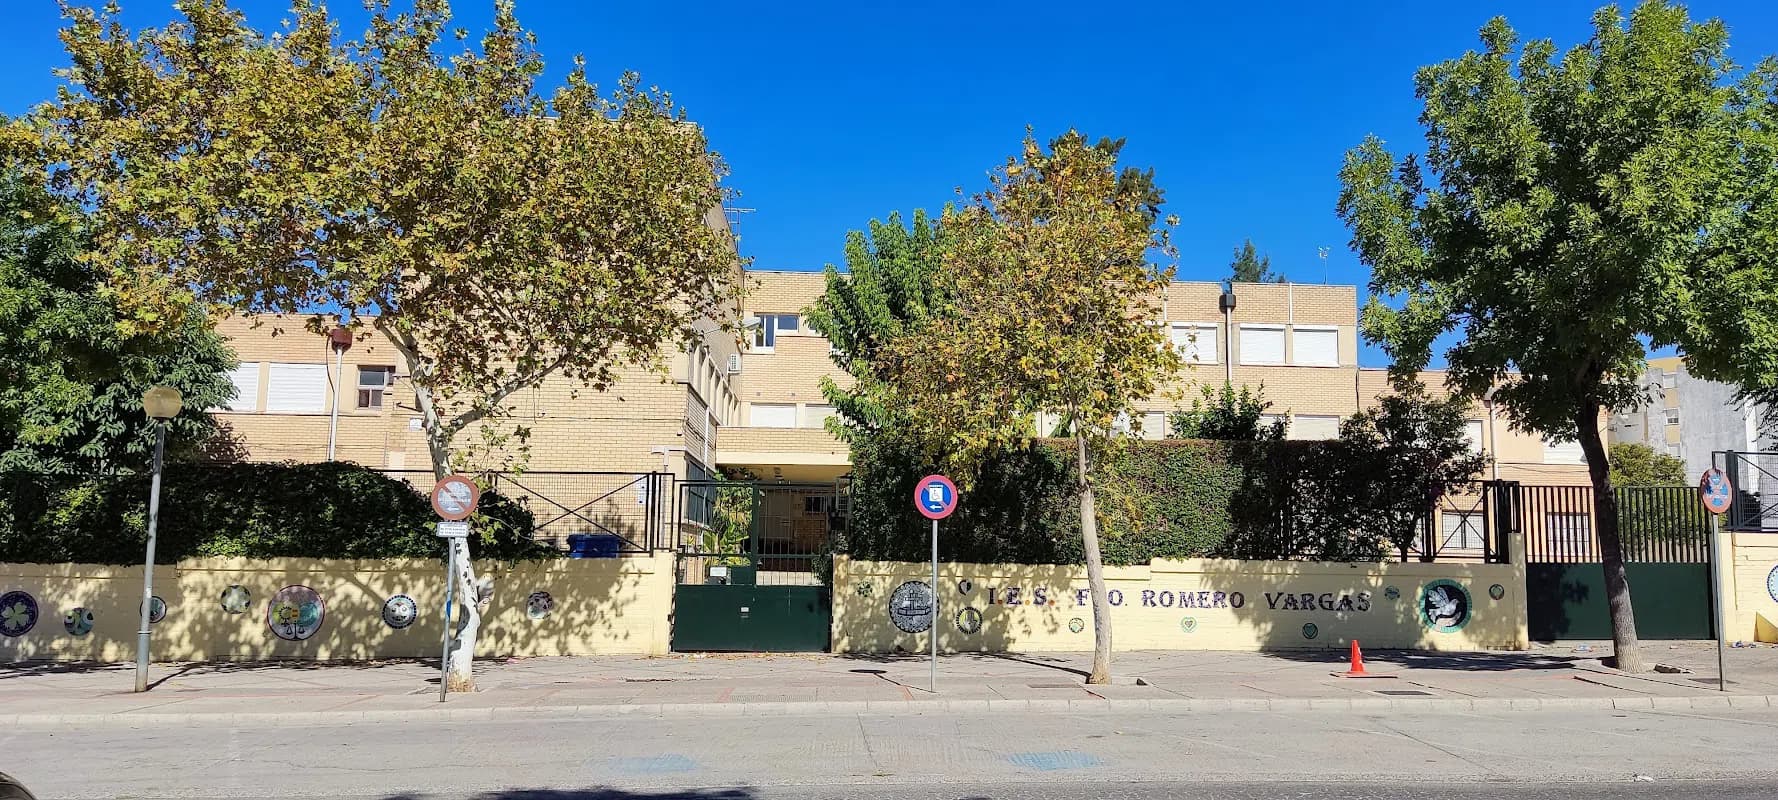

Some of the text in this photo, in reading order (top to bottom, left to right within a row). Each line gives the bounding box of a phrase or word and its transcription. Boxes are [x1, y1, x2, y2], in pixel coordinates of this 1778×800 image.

[988, 587, 1371, 612] I.E.S. FO. ROMERO VARGAS
